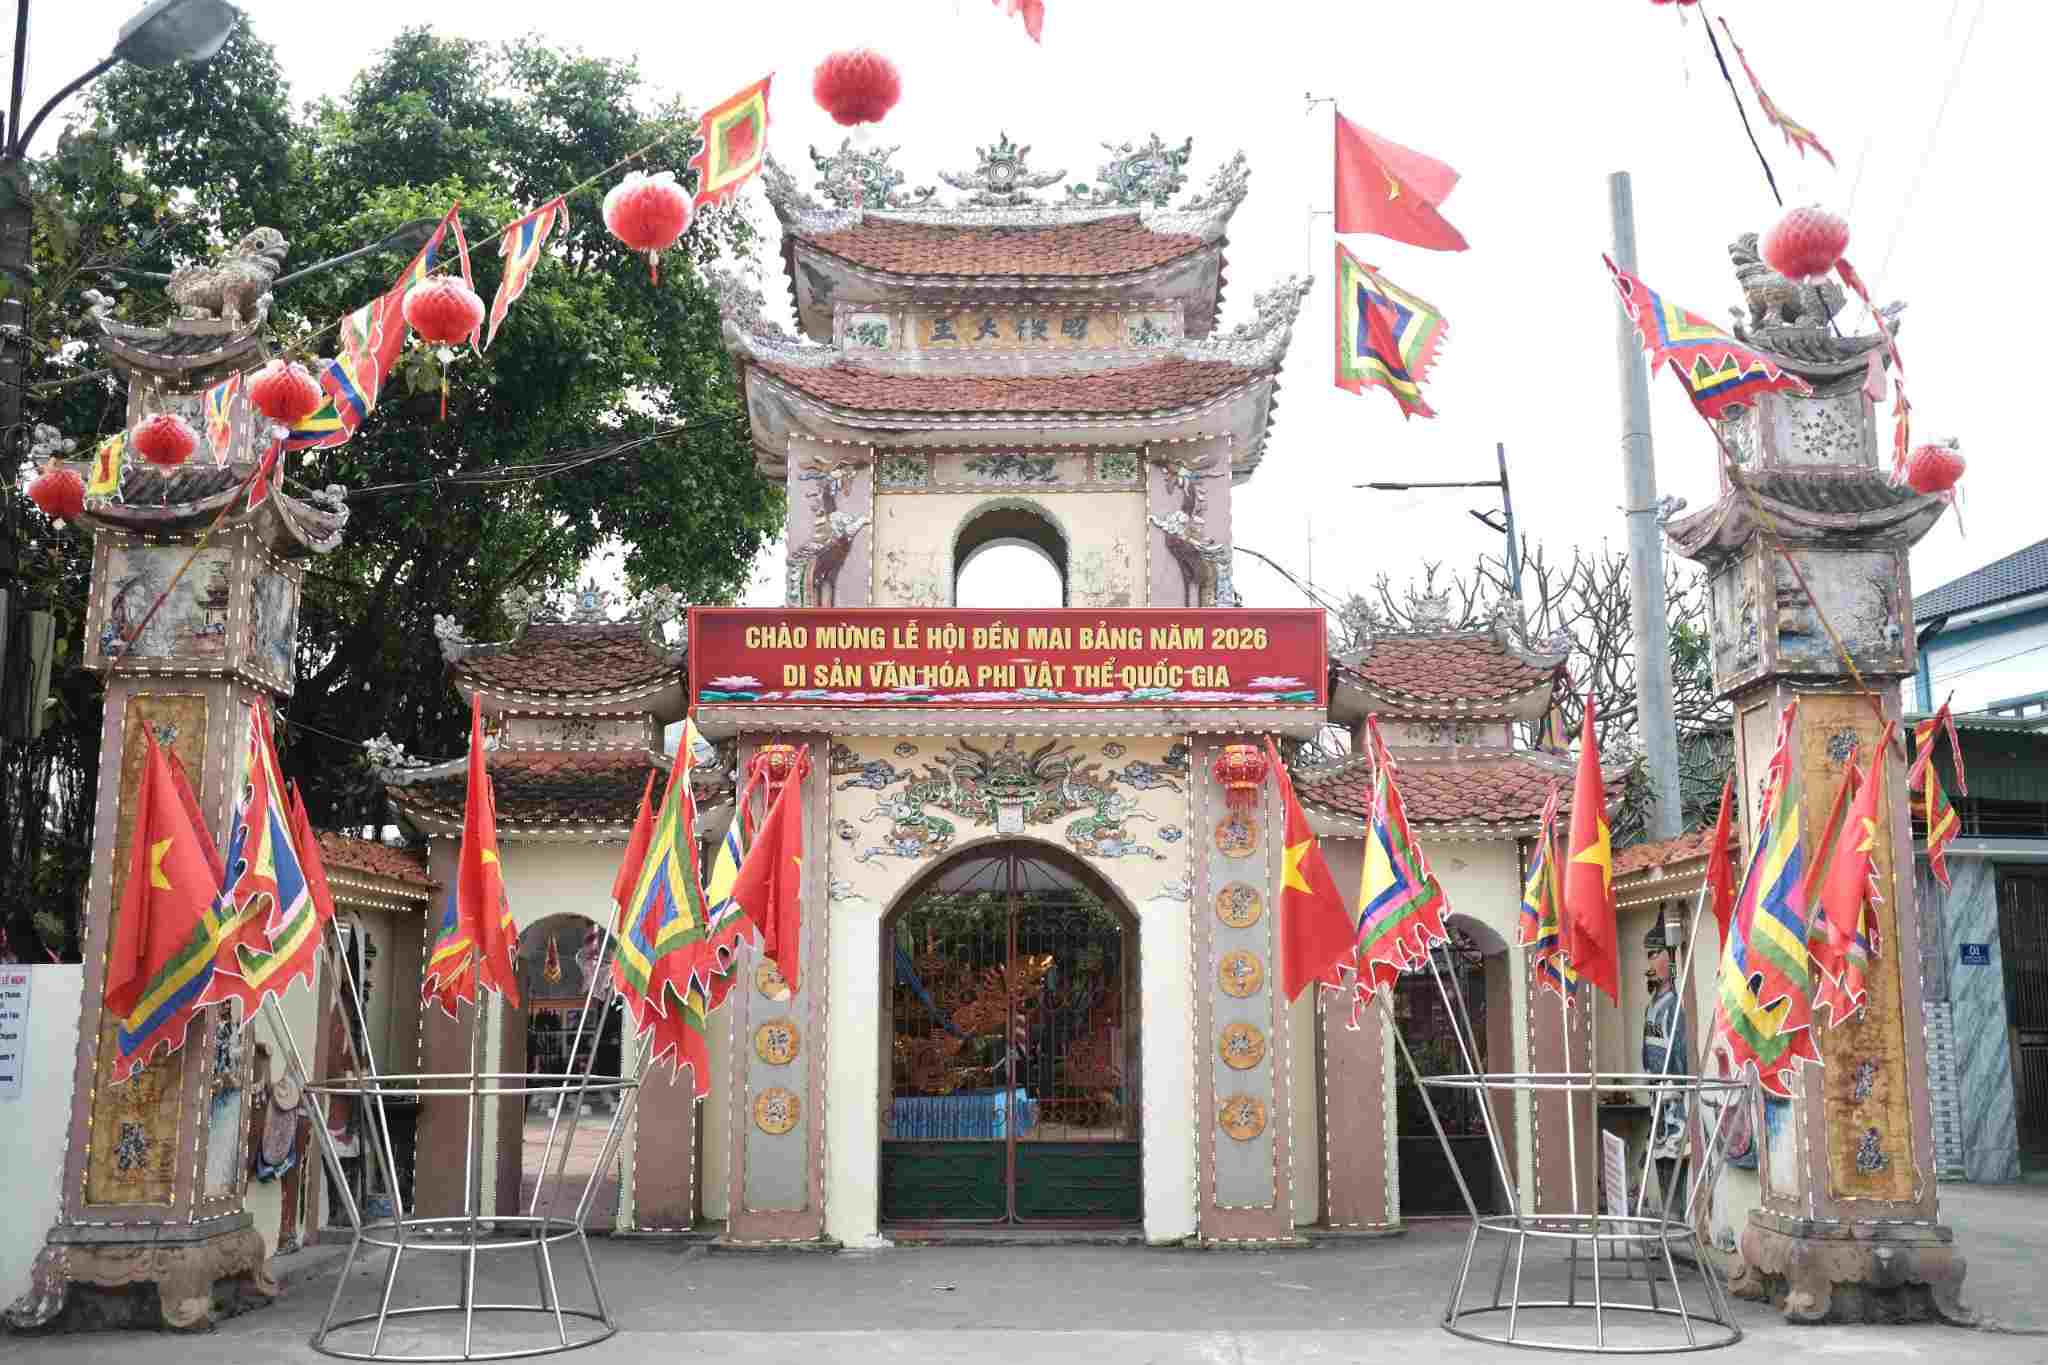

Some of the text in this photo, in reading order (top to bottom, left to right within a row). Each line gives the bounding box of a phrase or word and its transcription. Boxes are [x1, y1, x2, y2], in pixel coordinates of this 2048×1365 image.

[745, 618, 1267, 654] CHÀO MỪNG LỄ HỘI ĐỀN MAI BẢNG NĂM 2026
[783, 656, 1229, 691] DI SẢN VĂN HÓA PHI VẬT THỂ QUỐC GIA
